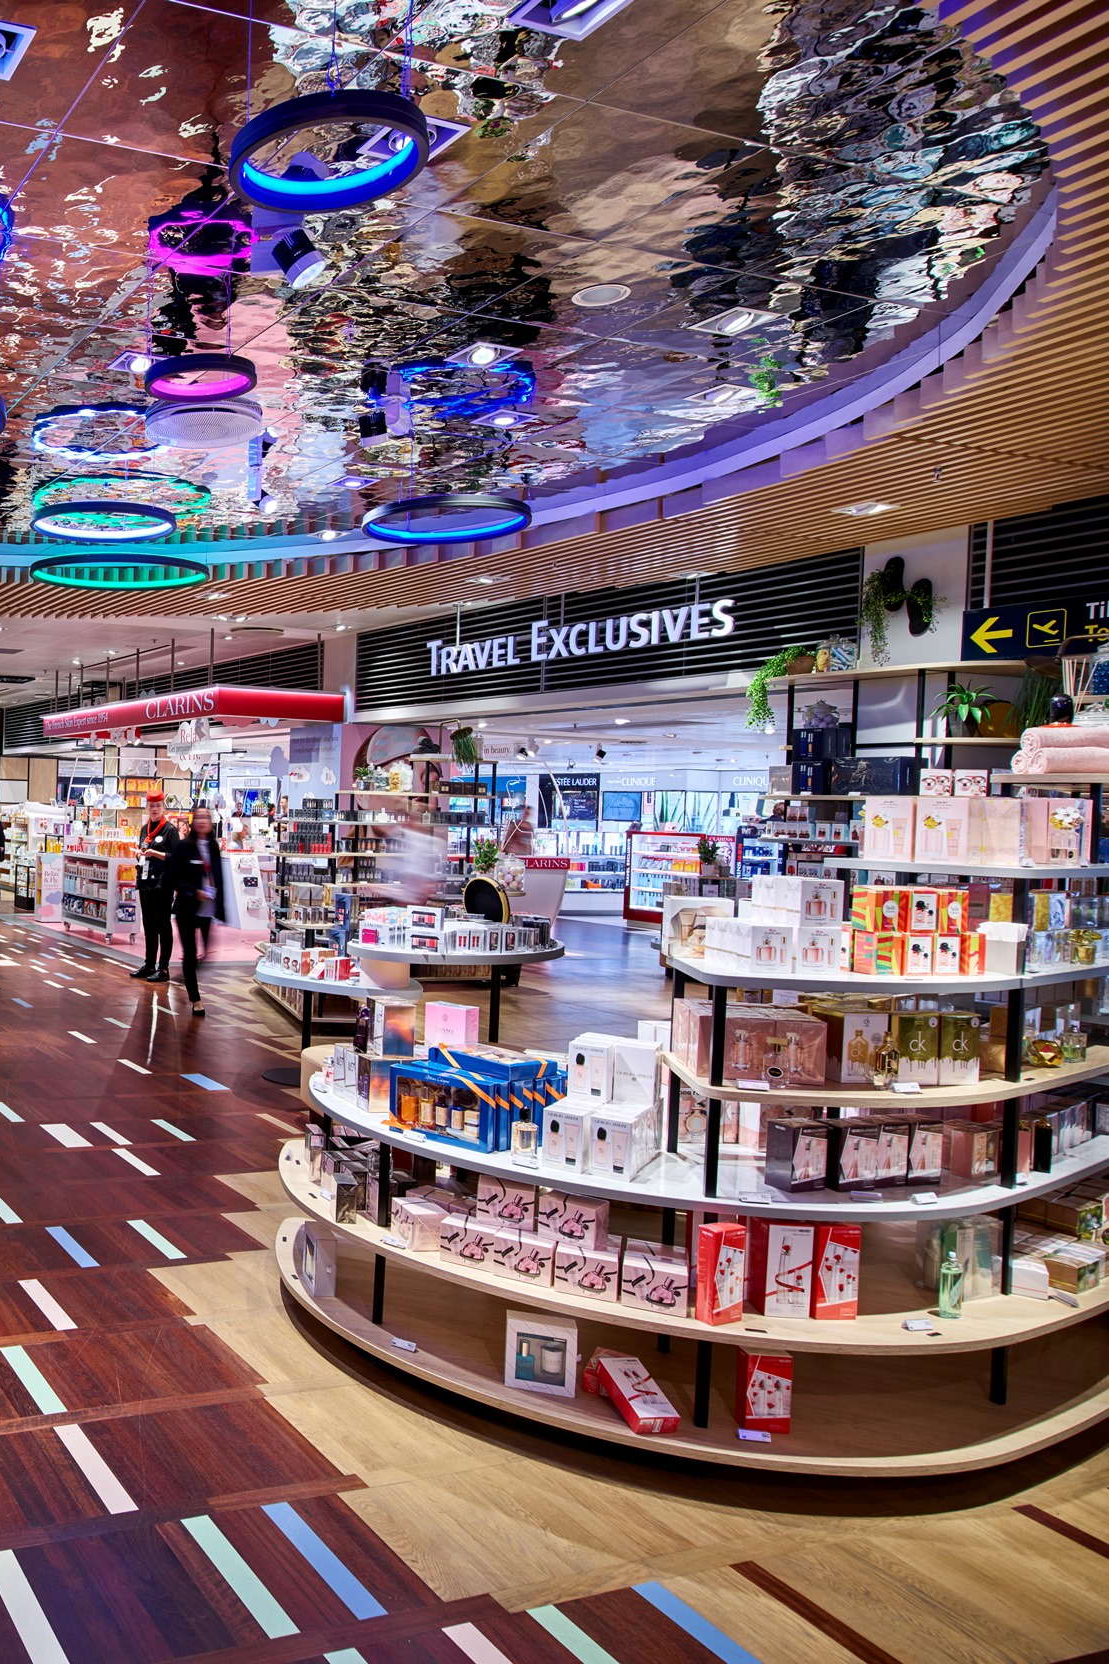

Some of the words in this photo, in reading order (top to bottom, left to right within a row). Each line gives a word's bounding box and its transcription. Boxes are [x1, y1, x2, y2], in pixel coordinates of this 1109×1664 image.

[427, 636, 520, 676] TRAVEL
[530, 599, 736, 662] EXCLUSIVES
[146, 691, 214, 720] CLARINS
[74, 716, 86, 730] Expert
[621, 777, 656, 787] CLINIQUE
[909, 1030, 927, 1052] ck
[952, 1030, 969, 1052] ck
